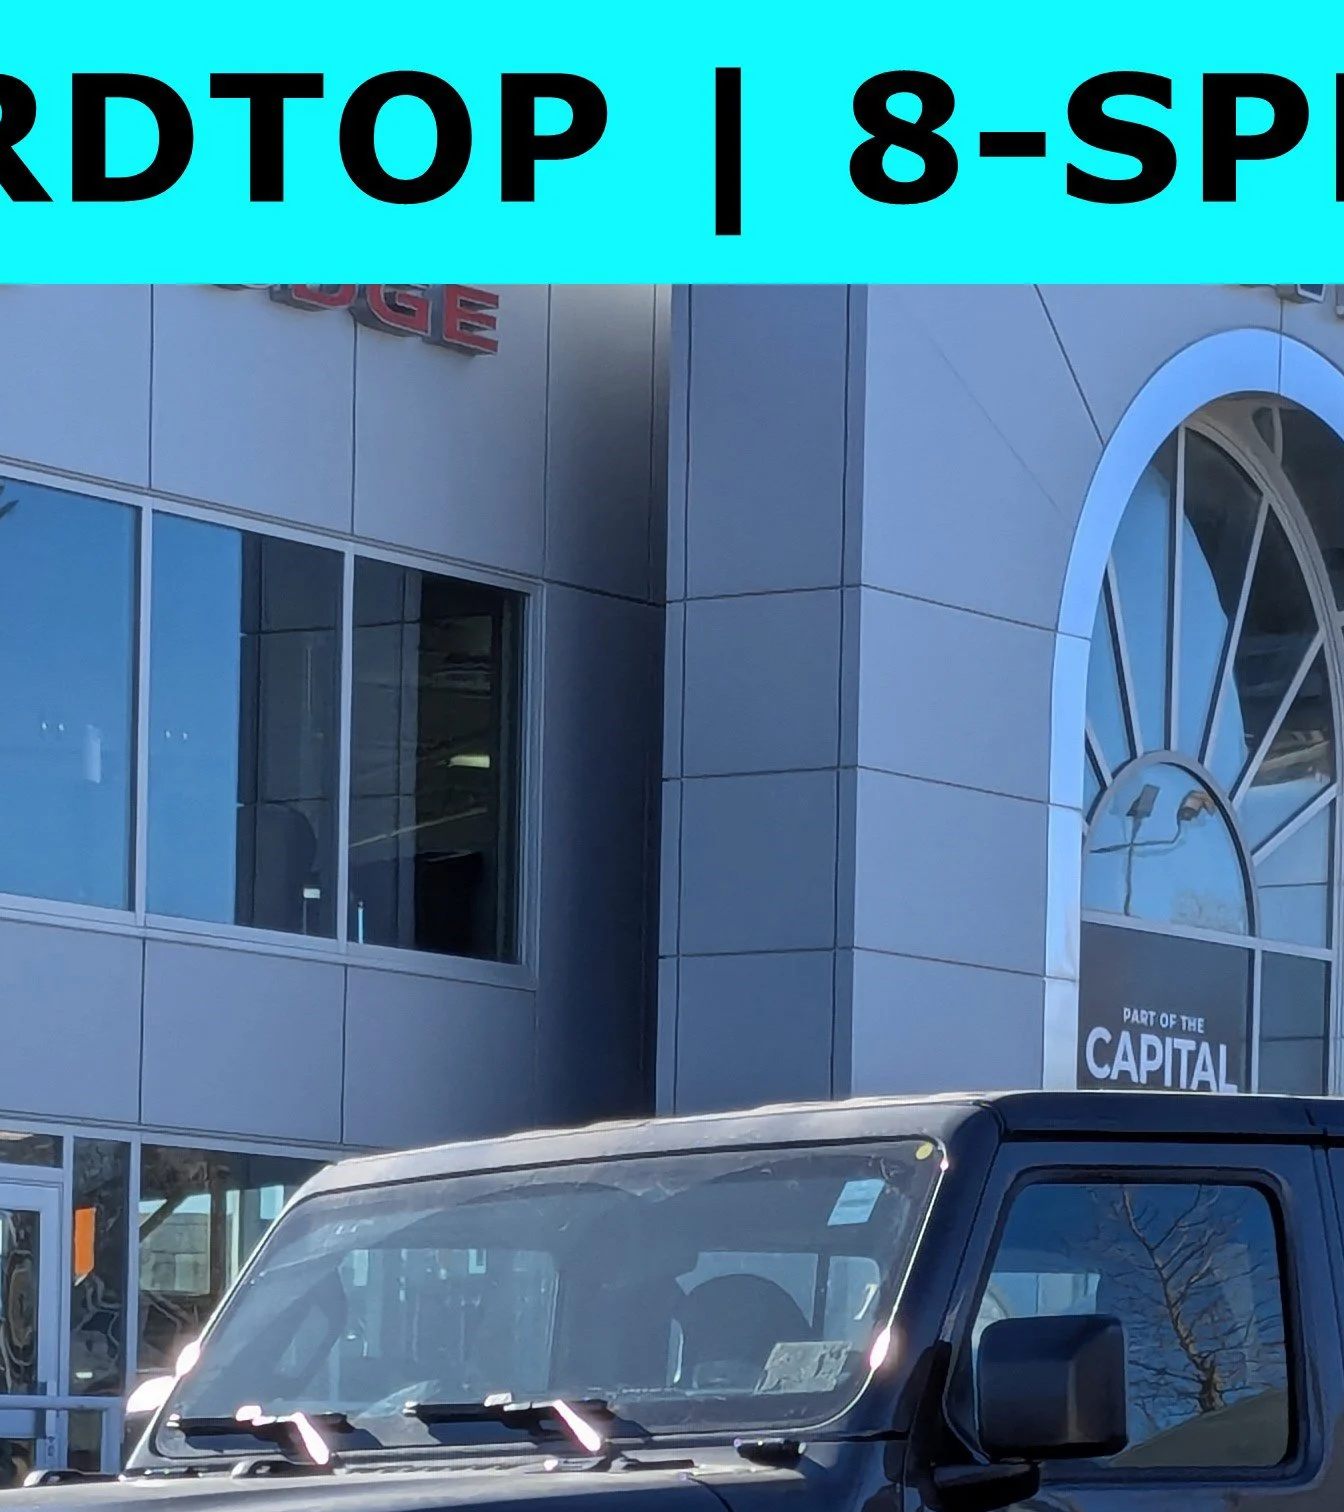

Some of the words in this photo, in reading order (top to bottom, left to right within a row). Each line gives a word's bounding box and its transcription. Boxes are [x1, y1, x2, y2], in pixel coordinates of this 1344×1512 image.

[1123, 1007, 1156, 1027] PART
[1160, 1012, 1177, 1028] OF
[1180, 1015, 1205, 1034] THE
[1085, 1026, 1238, 1094] CAPITAL
